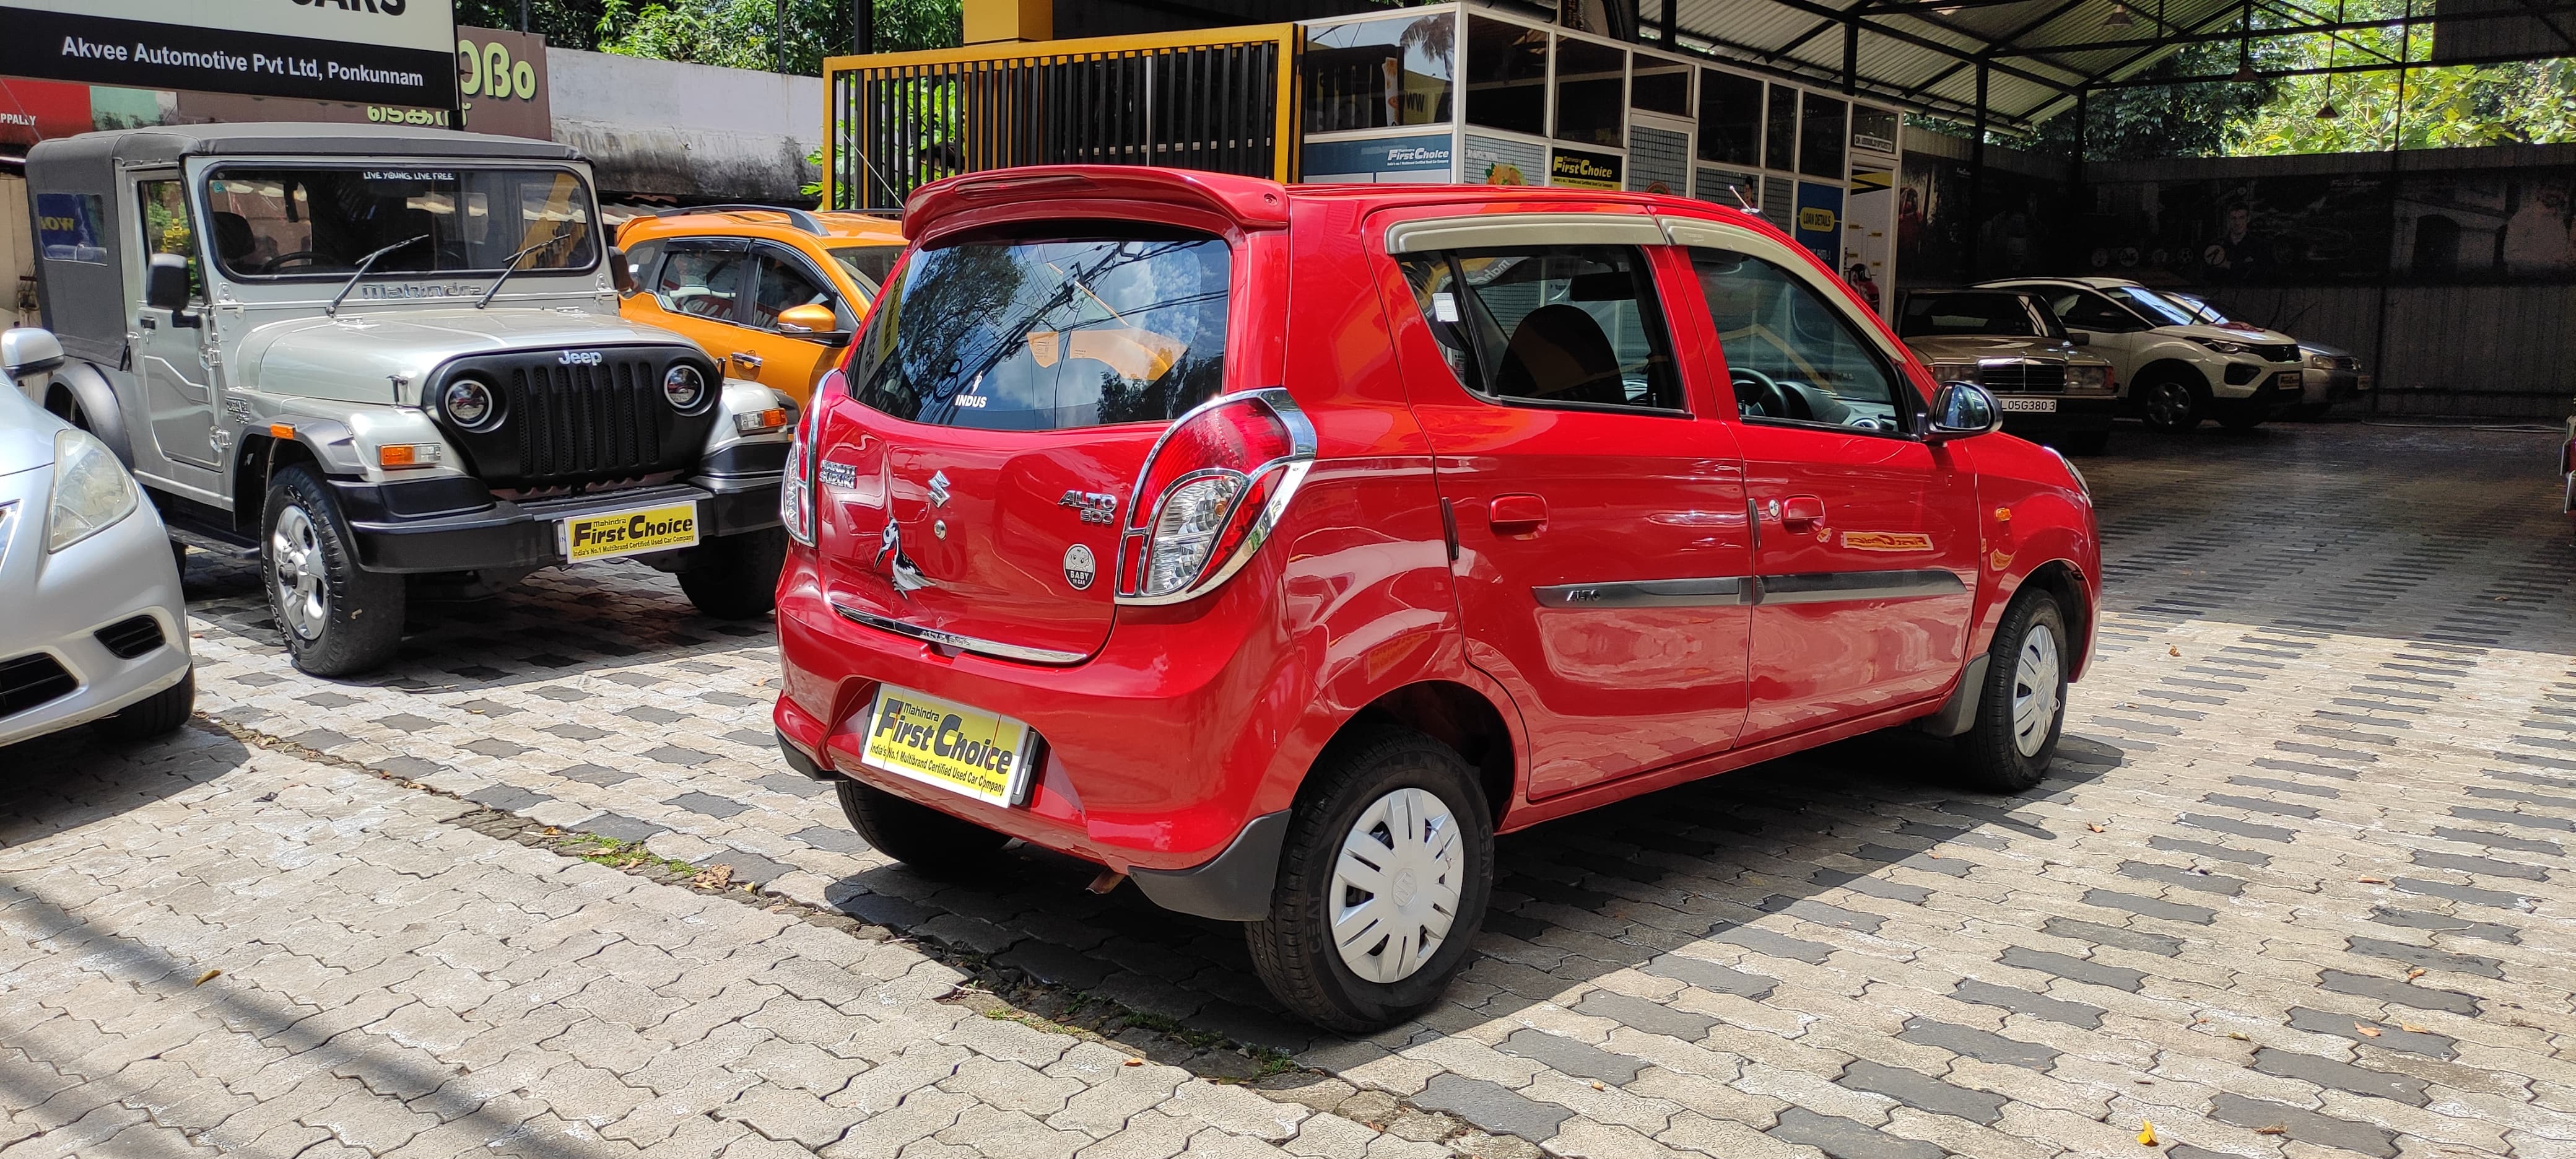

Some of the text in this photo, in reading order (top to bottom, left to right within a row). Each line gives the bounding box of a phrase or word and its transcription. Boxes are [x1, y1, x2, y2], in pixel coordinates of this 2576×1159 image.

[62, 36, 424, 87] Akvee Automotive Pvt Ltd, Ponkunnam
[0, 113, 36, 126] PPALLY
[1387, 149, 1414, 161] First
[1414, 147, 1449, 159] Choice
[363, 171, 382, 180] LIVE
[414, 172, 432, 180] LIVE
[432, 172, 455, 180] FREE
[1552, 156, 1612, 178] First Choice
[362, 282, 483, 300] Mahindra
[558, 349, 603, 365] Jeep
[955, 395, 987, 408] INDUS
[819, 470, 857, 489] SUZUKI
[1058, 490, 1117, 512] ALTO
[593, 518, 627, 527] Mahindra
[1080, 509, 1114, 525] 800
[573, 515, 693, 547] First Choice
[603, 543, 629, 553] Multibrand
[629, 540, 650, 549] Certified
[651, 538, 663, 546] Used
[673, 535, 694, 544] Company
[1070, 571, 1089, 580] BABY
[903, 702, 940, 722] Mahindra
[874, 698, 1013, 774] First Choice
[870, 743, 1006, 797] India's No.1 Multibrand Certified Used Car Company
